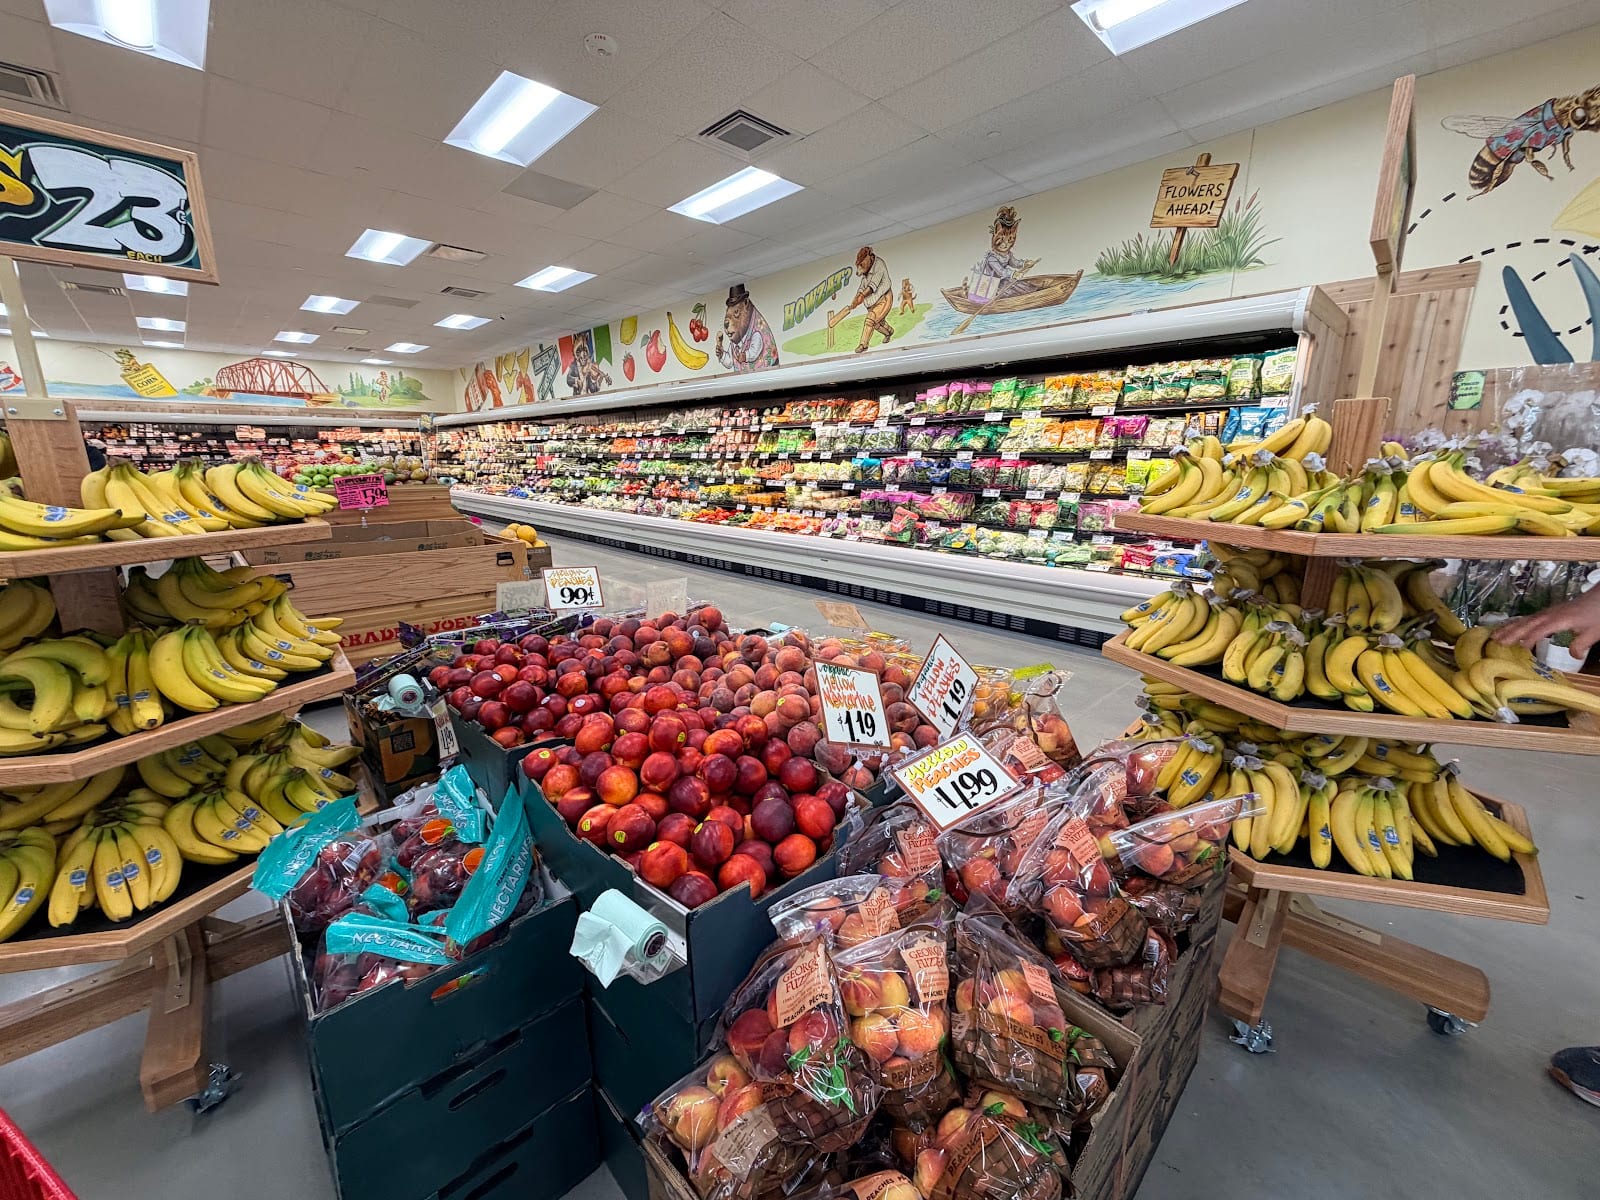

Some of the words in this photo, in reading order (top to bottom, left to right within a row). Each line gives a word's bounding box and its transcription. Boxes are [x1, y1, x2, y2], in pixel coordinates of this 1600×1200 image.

[1164, 183, 1225, 199] FLOWERS
[1166, 200, 1215, 216] AHEAD!
[126, 250, 163, 263] EACH
[782, 266, 853, 332] HOWZAT?
[136, 376, 159, 388] CORN
[550, 575, 595, 588] PEACHES
[560, 586, 595, 605] 99¢
[428, 615, 480, 634] JOE'S
[918, 658, 946, 701] YELLOW
[927, 657, 961, 718] PEACHES
[837, 710, 876, 743] $1.19
[911, 748, 981, 794] PEACHES
[933, 768, 998, 810] $4.99
[352, 932, 446, 956] NECTARIN
[784, 1004, 806, 1024] PEACHES
